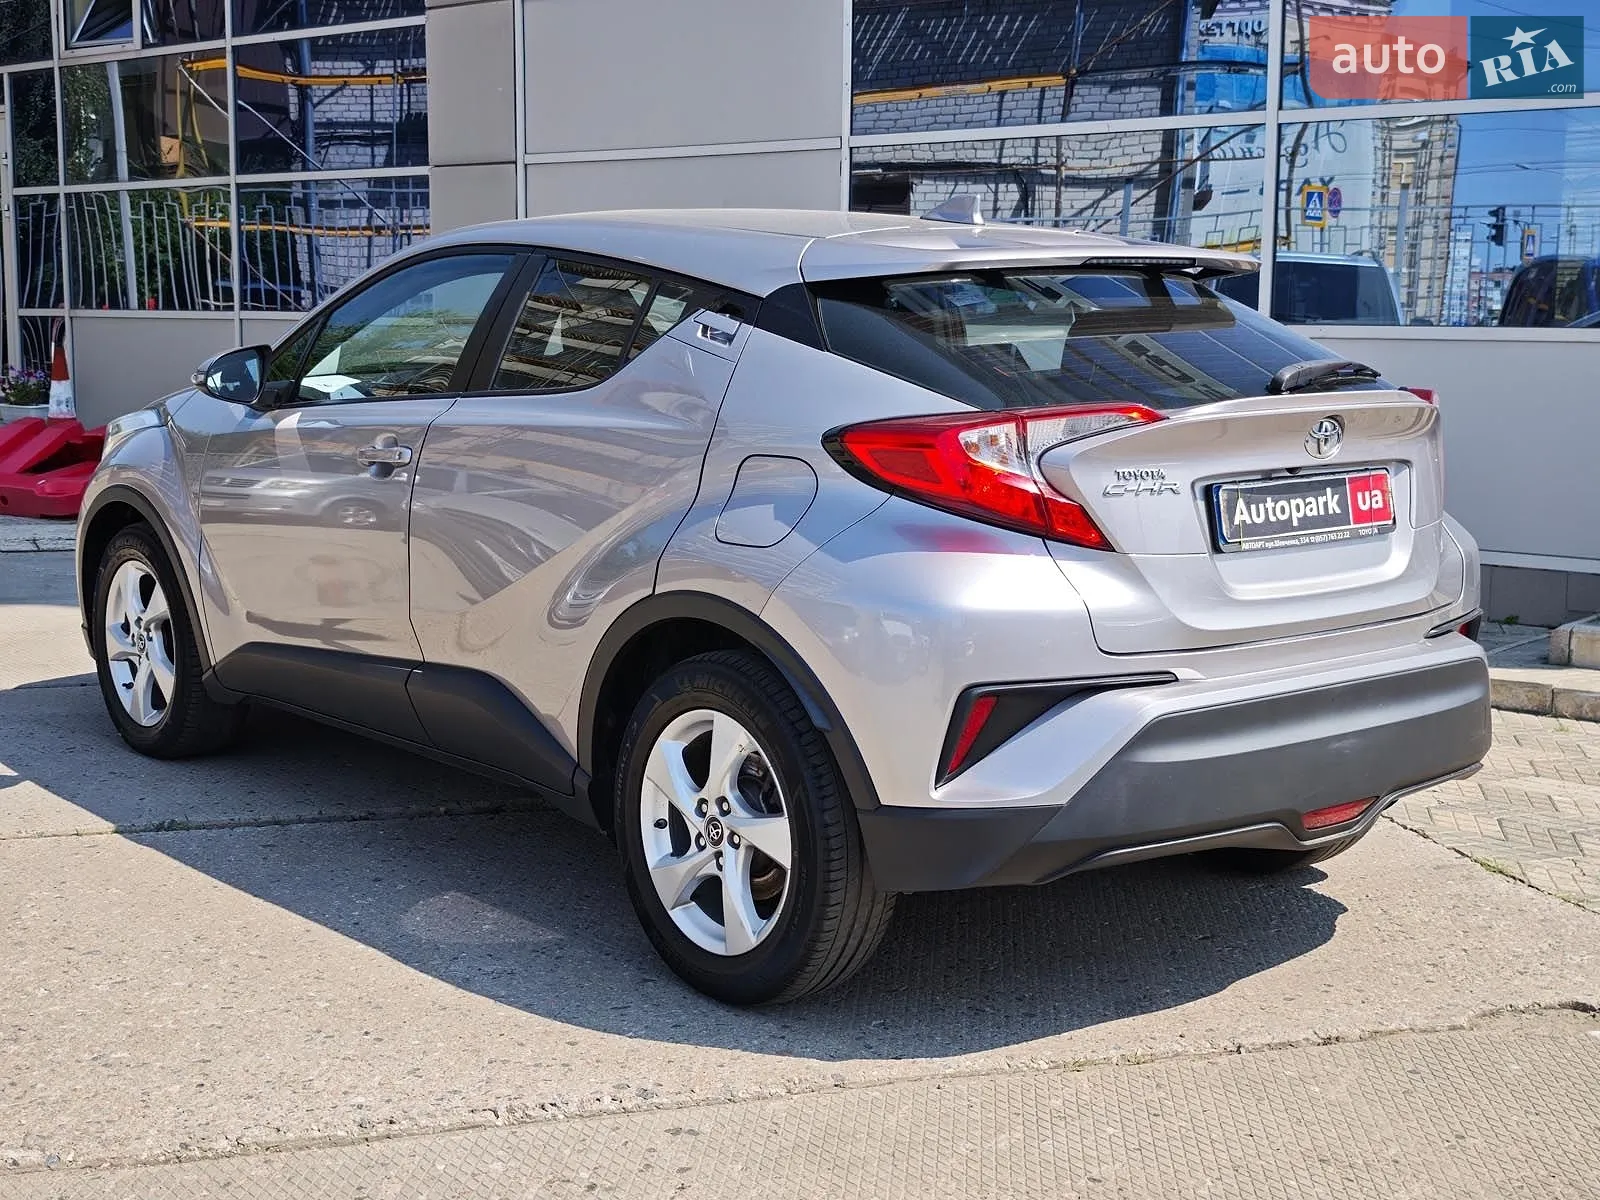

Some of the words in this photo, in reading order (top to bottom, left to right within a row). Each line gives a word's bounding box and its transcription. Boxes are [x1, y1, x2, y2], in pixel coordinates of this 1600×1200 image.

[1114, 469, 1166, 481] TOYOTA
[1102, 481, 1181, 498] C-HR
[1233, 487, 1342, 526] Autopark
[1356, 489, 1383, 511] ua
